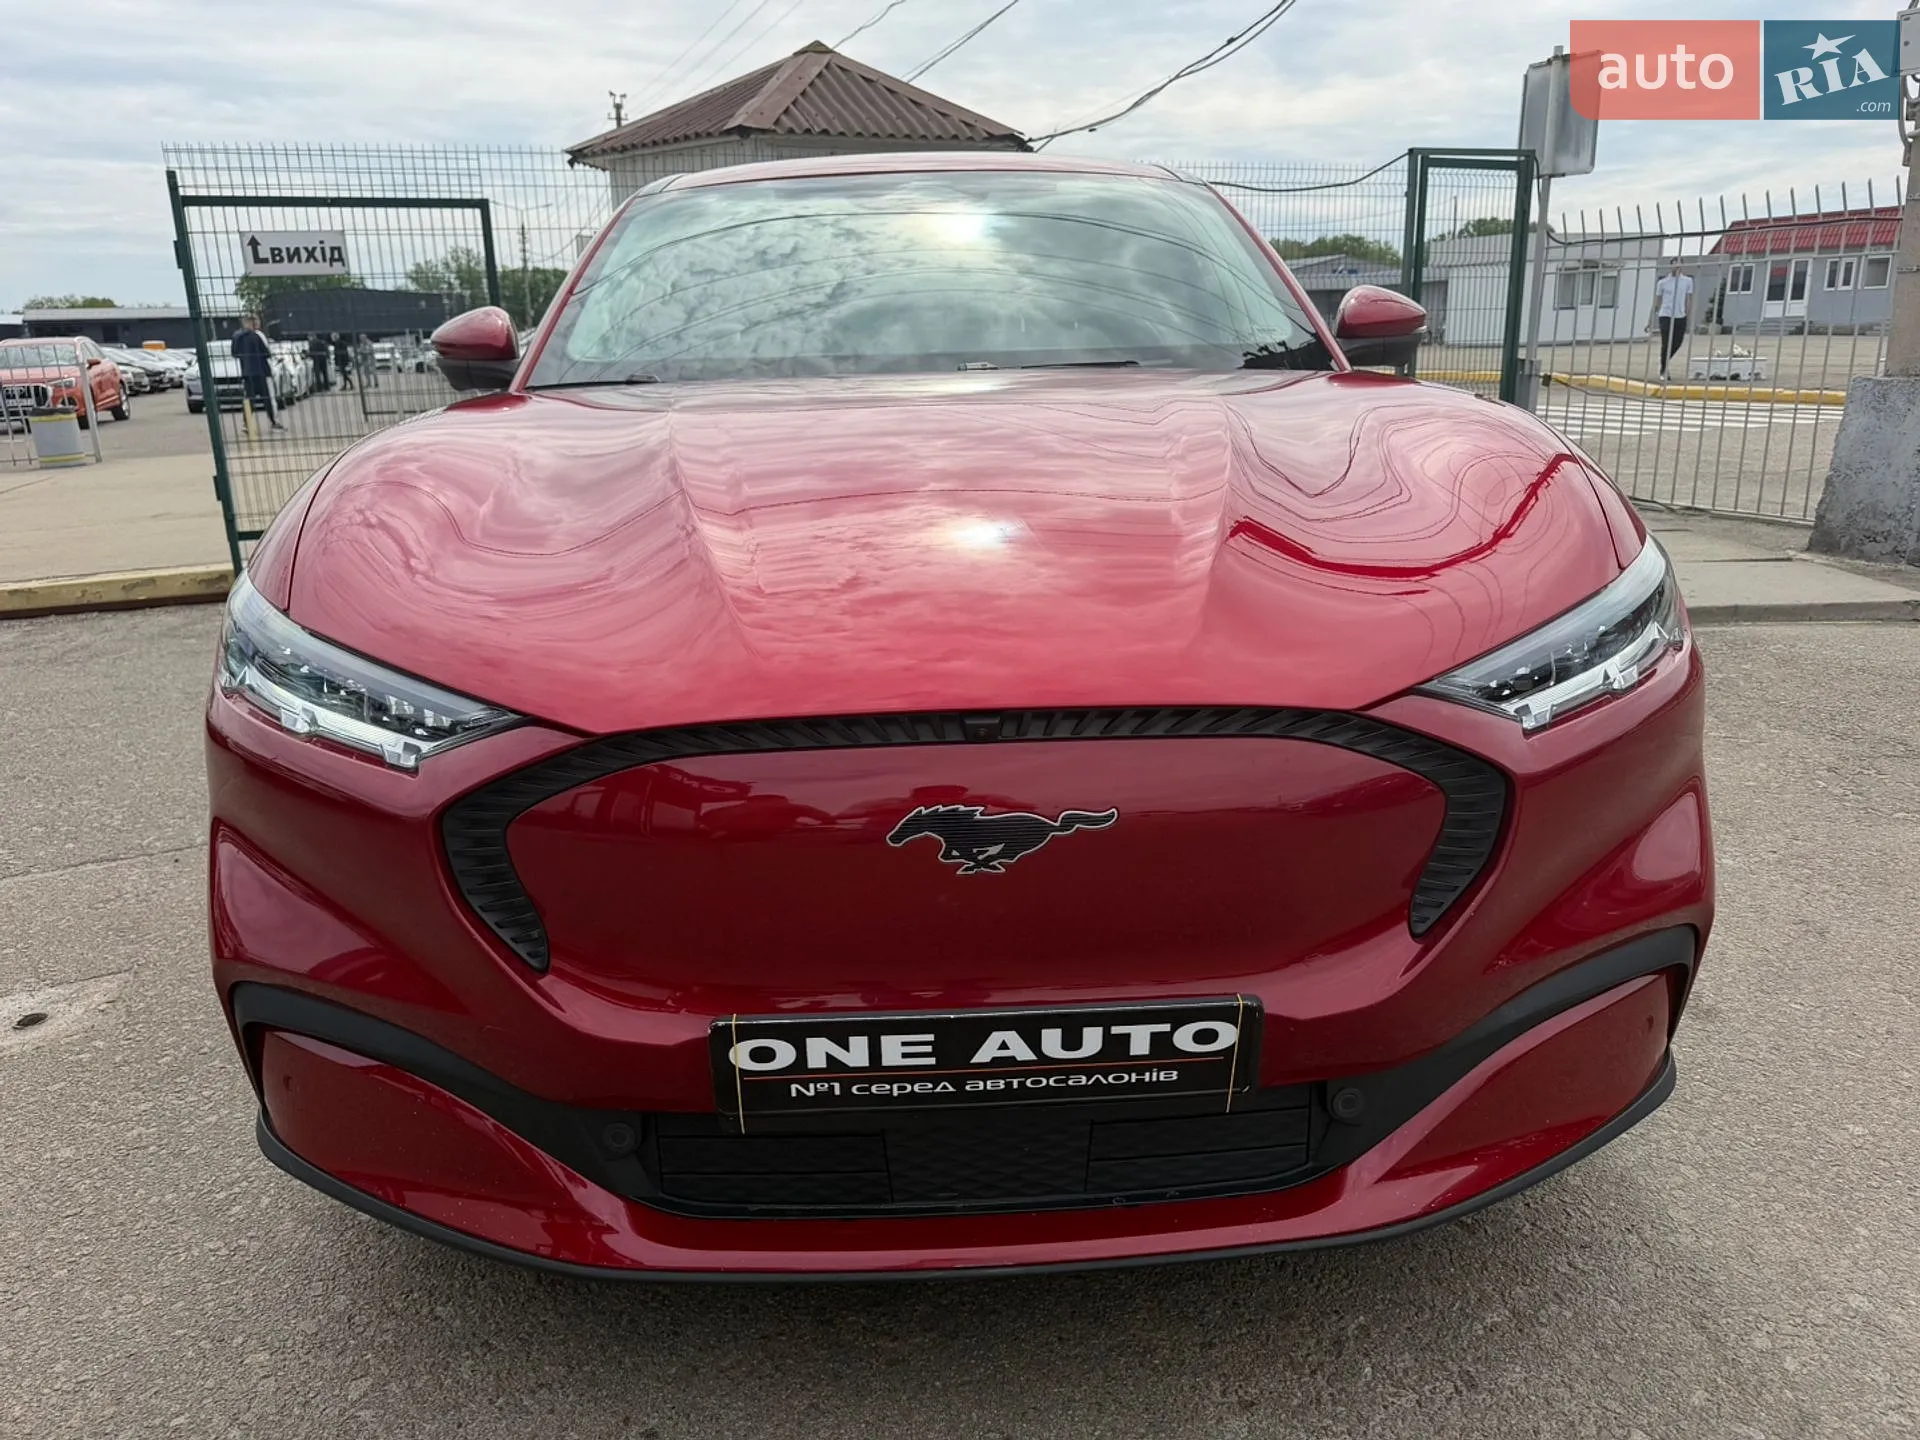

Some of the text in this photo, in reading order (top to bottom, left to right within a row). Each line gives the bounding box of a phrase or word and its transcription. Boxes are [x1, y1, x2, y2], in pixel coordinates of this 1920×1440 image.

[269, 240, 346, 268] вихід
[729, 1021, 1239, 1072] ONE AUTO
[790, 1068, 1179, 1098] №1 серед автосалонів
